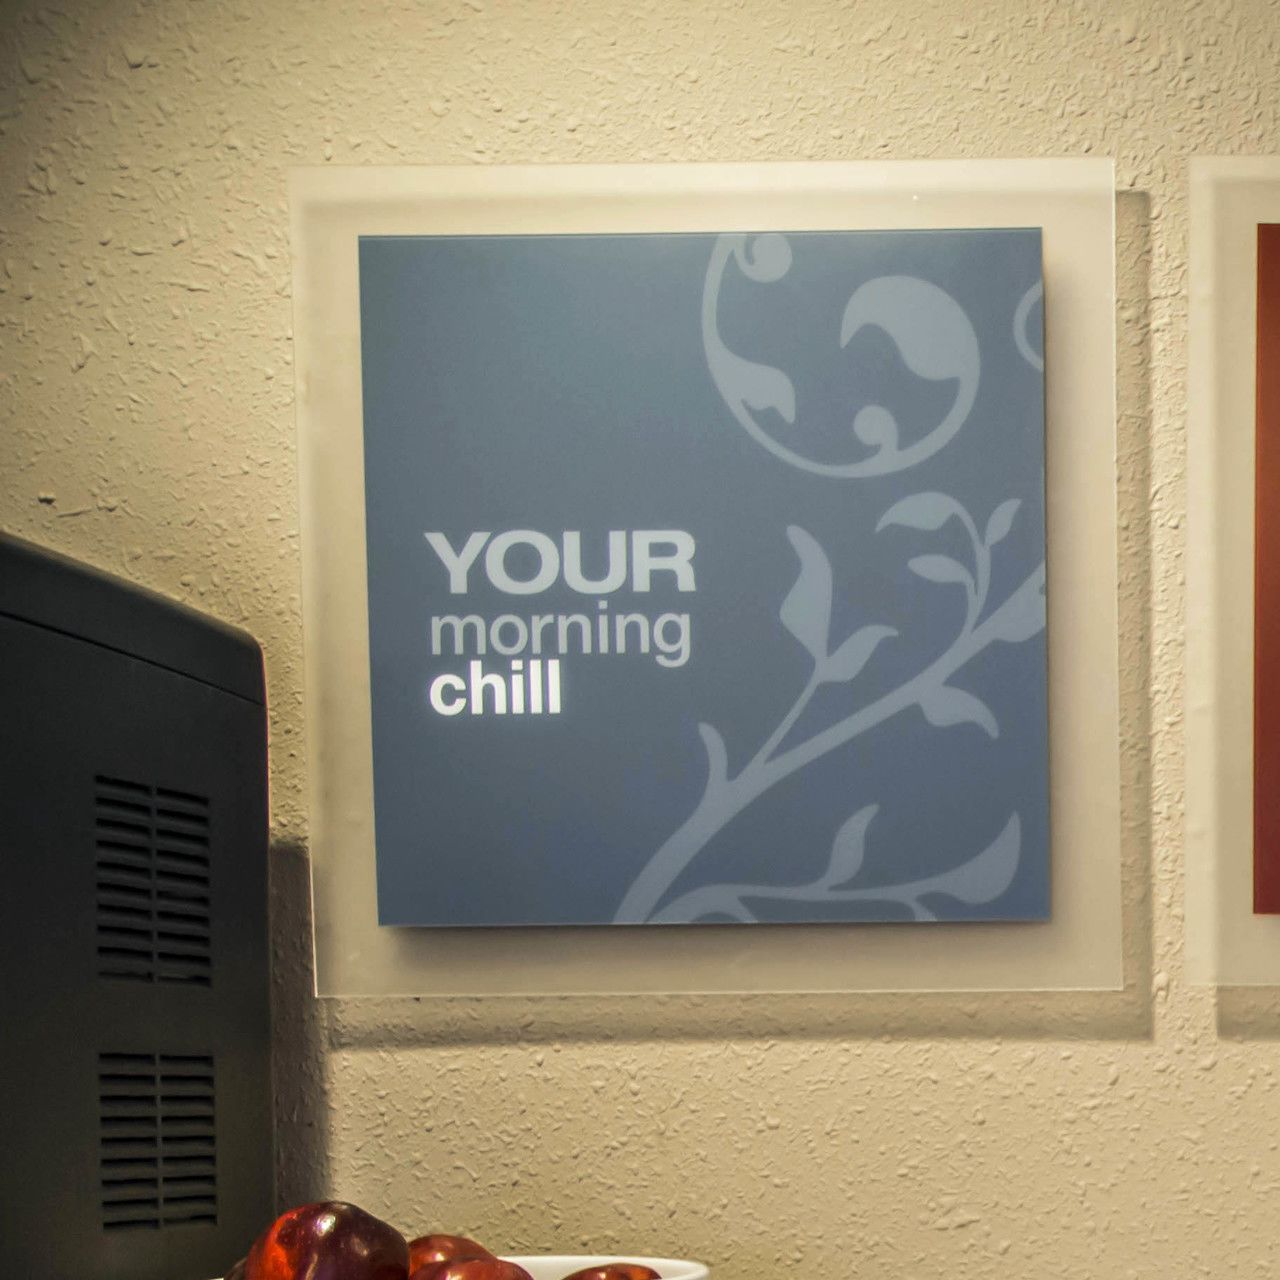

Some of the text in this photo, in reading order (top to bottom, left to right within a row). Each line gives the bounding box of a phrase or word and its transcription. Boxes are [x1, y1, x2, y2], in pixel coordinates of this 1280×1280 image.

[424, 530, 696, 594] YOUR
[431, 601, 690, 668] morning
[430, 659, 561, 716] chill
